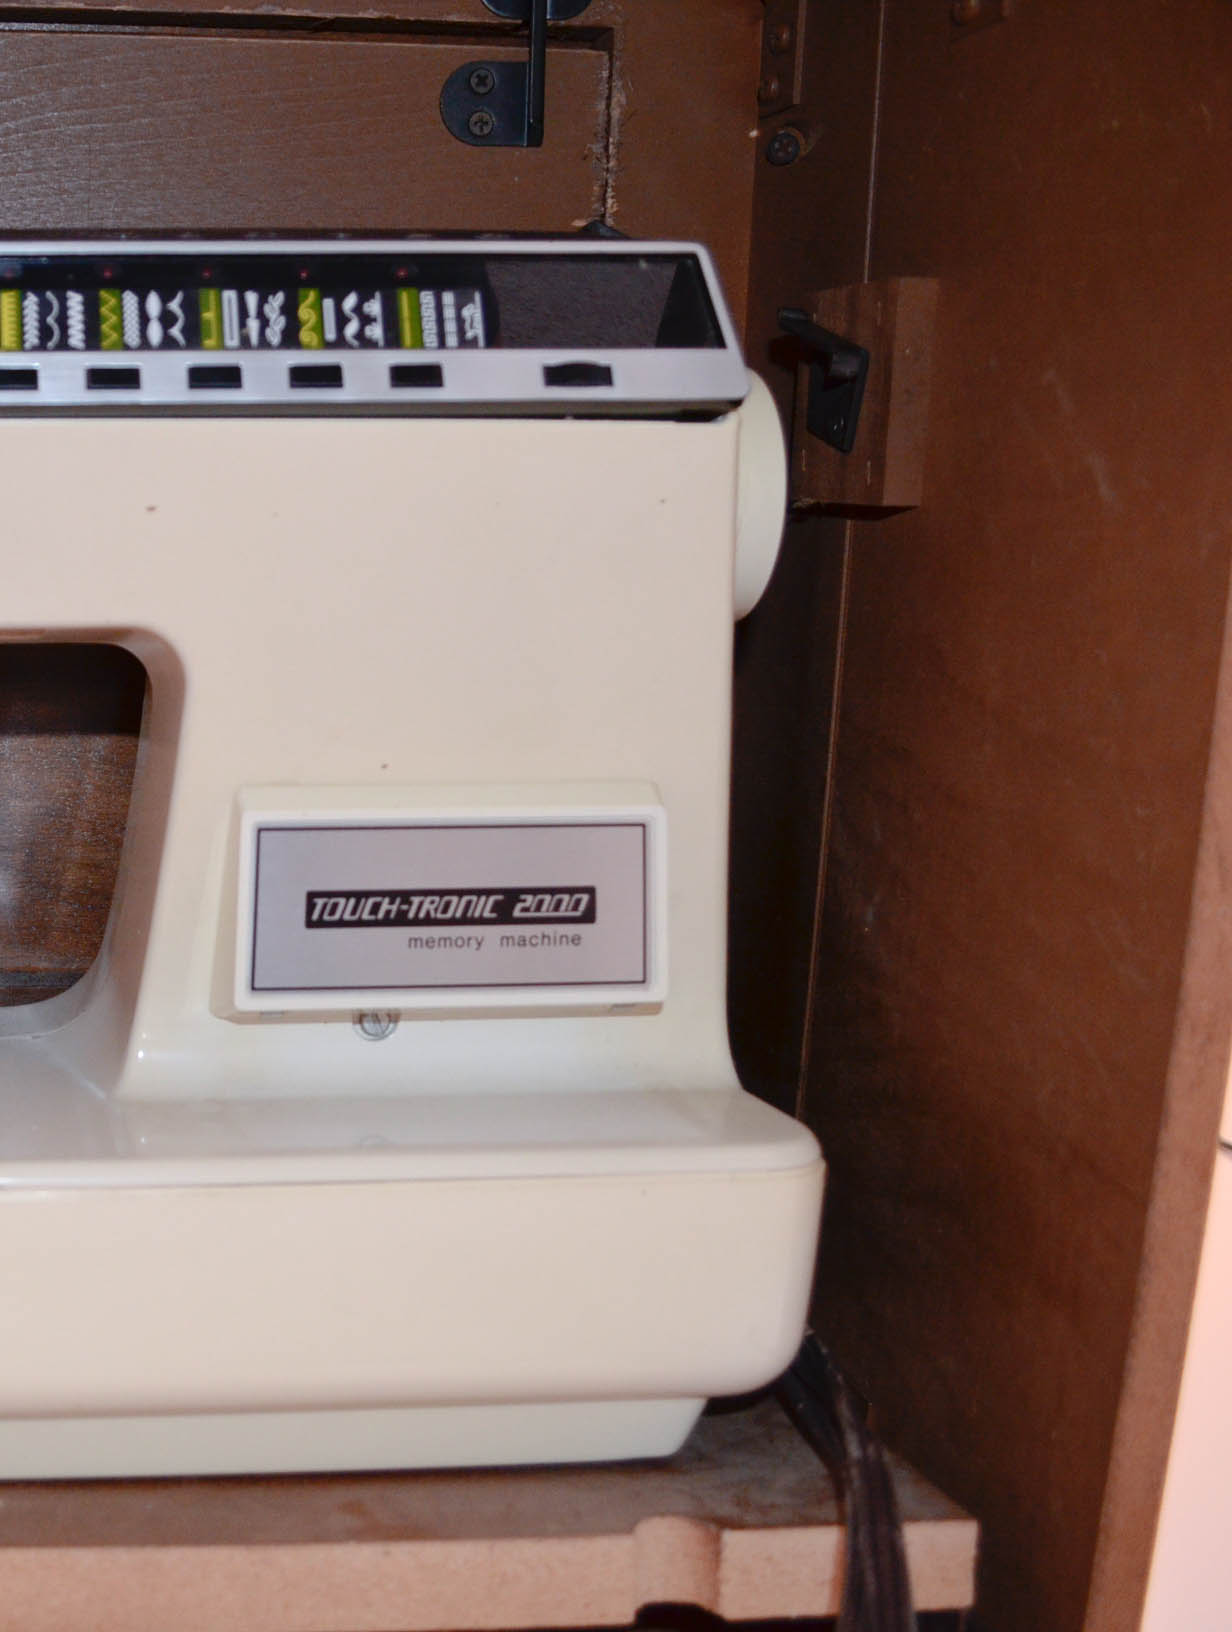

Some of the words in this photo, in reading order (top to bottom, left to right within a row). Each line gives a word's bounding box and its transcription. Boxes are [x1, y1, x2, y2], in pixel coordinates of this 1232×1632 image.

[310, 894, 504, 922] TOUCH-TRONIC
[512, 893, 590, 918] 2000
[408, 933, 485, 951] memory
[500, 931, 583, 949] machine
